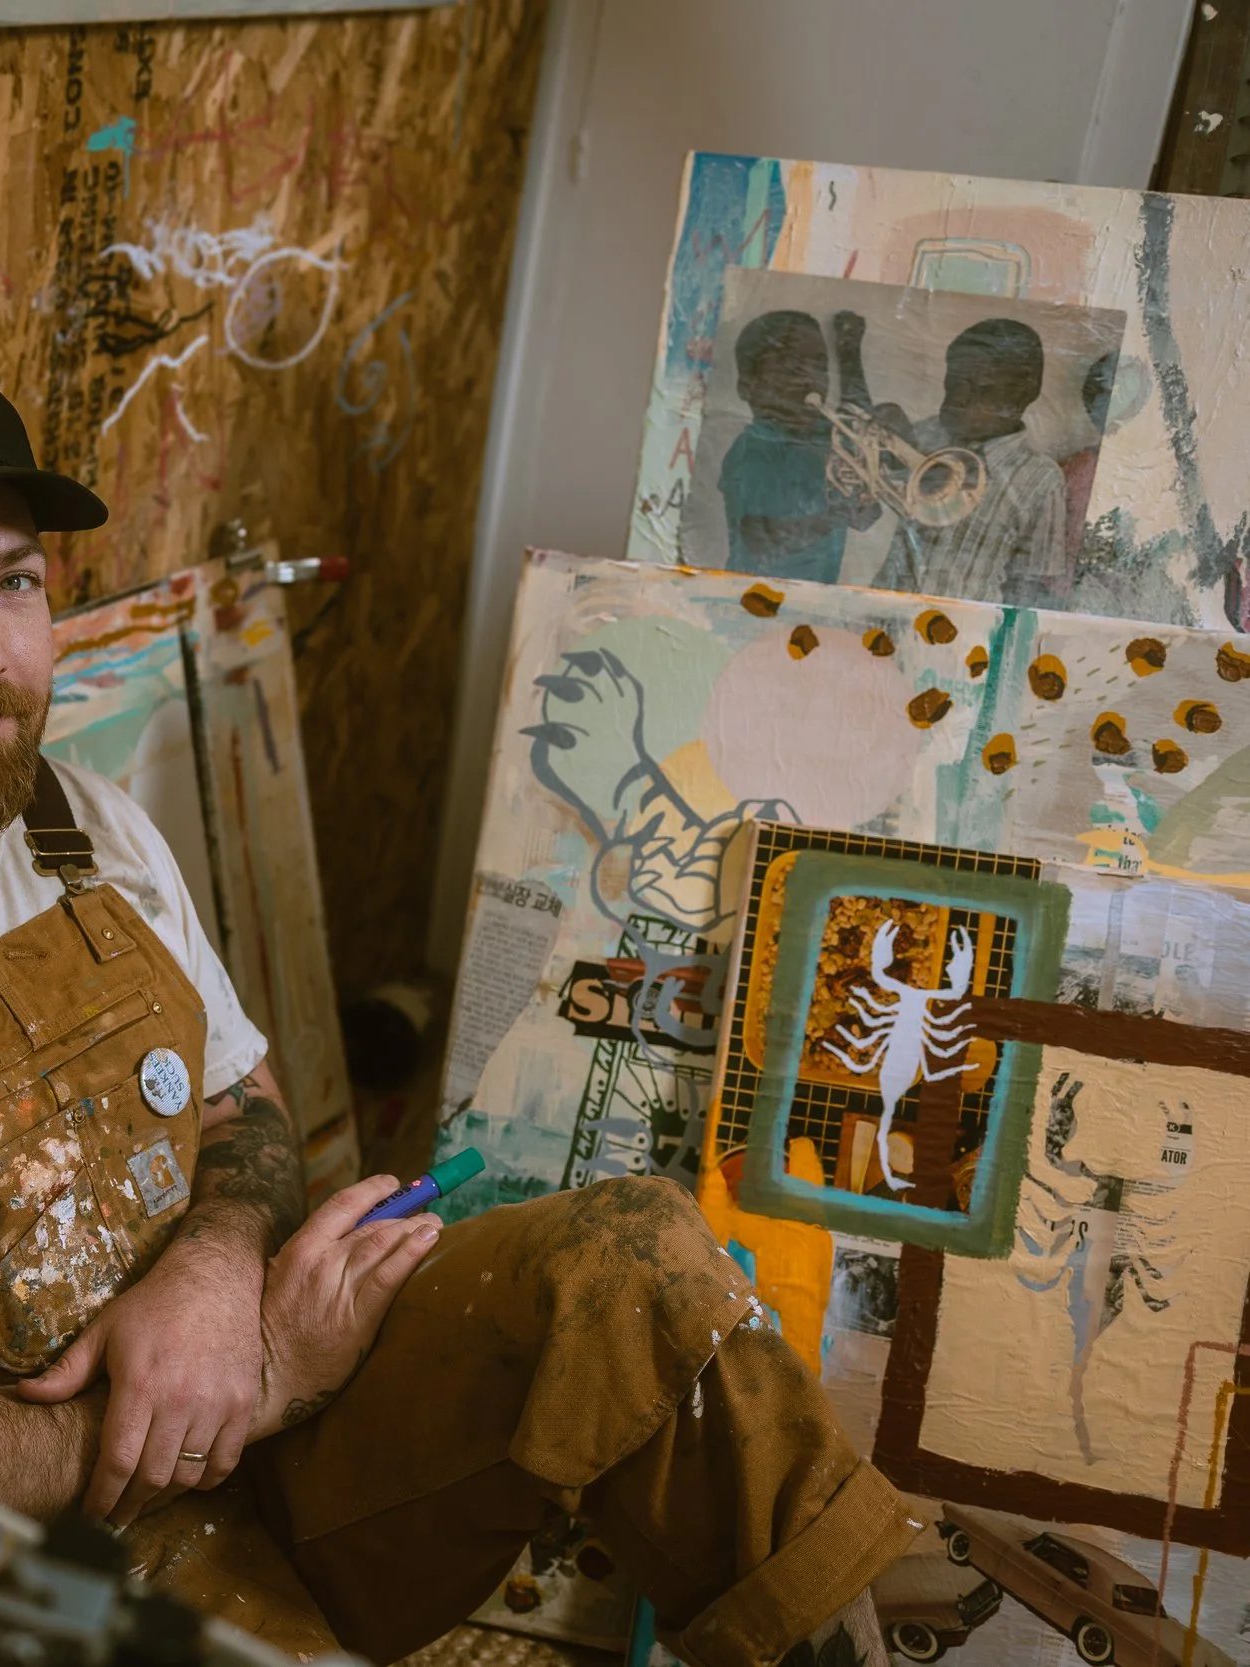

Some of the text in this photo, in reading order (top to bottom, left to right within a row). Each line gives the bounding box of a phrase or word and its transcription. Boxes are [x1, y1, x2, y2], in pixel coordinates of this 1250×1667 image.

[150, 1052, 183, 1111] YANKEES
[163, 1055, 185, 1092] SUCK
[1160, 1149, 1187, 1165] ATOR
